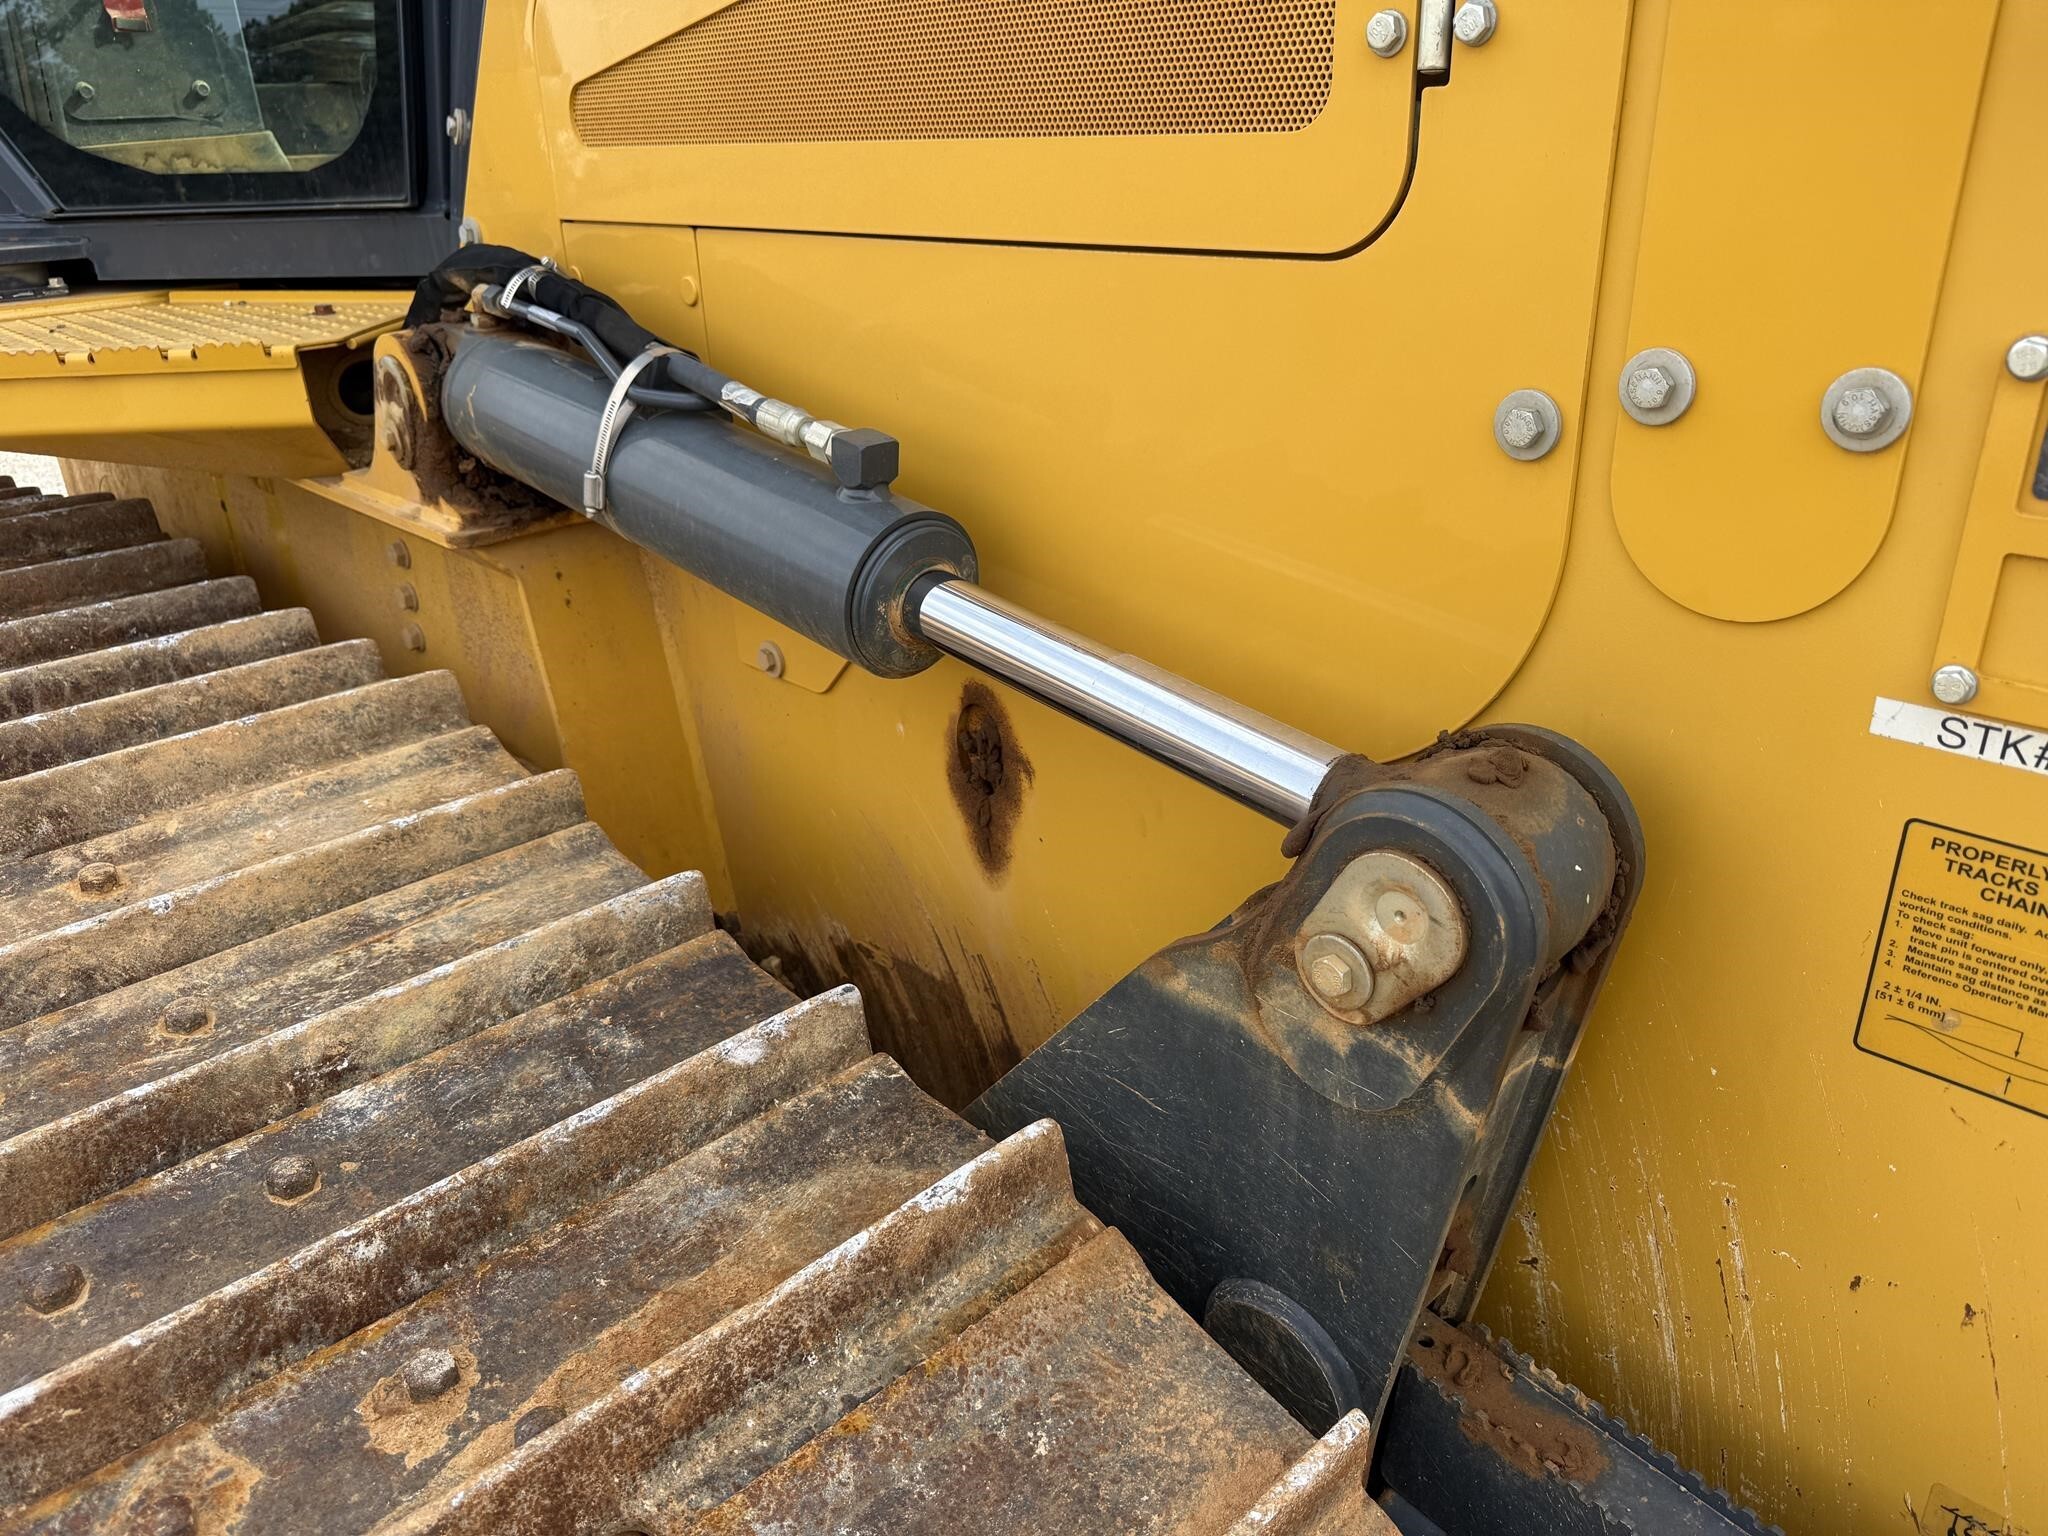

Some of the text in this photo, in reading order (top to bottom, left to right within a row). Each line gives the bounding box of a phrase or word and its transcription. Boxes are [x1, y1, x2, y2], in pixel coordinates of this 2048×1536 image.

[1937, 716, 2048, 770] STK#
[1944, 858, 2039, 896] TRACKS
[1897, 909, 1974, 940] To check sag:
[1899, 901, 2012, 940] working conditions.
[1901, 889, 1936, 905] Check
[1940, 901, 1968, 915] track
[1972, 911, 1993, 924] sag
[1997, 918, 2027, 933] daily.
[1889, 939, 1898, 948] 2.
[1907, 945, 1955, 966] Measure
[1958, 962, 1979, 975] sag
[1982, 970, 1993, 979] at
[1996, 972, 2015, 985] the
[1895, 920, 2047, 974] 1. Move unit forward only.
[1910, 935, 1938, 950] track
[1941, 946, 1959, 957] pin
[1962, 951, 1972, 960] is
[1975, 956, 2028, 978] centered
[1883, 981, 1942, 1008] 2 ± 1/4 IN.
[1884, 960, 1893, 968] 4.
[1902, 964, 1959, 989] Reference
[1962, 984, 2024, 1010] Operator's
[1887, 949, 2047, 1007] 3. Maintain sag distance as
[1875, 989, 1946, 1022] [51 ± 6 mm]
